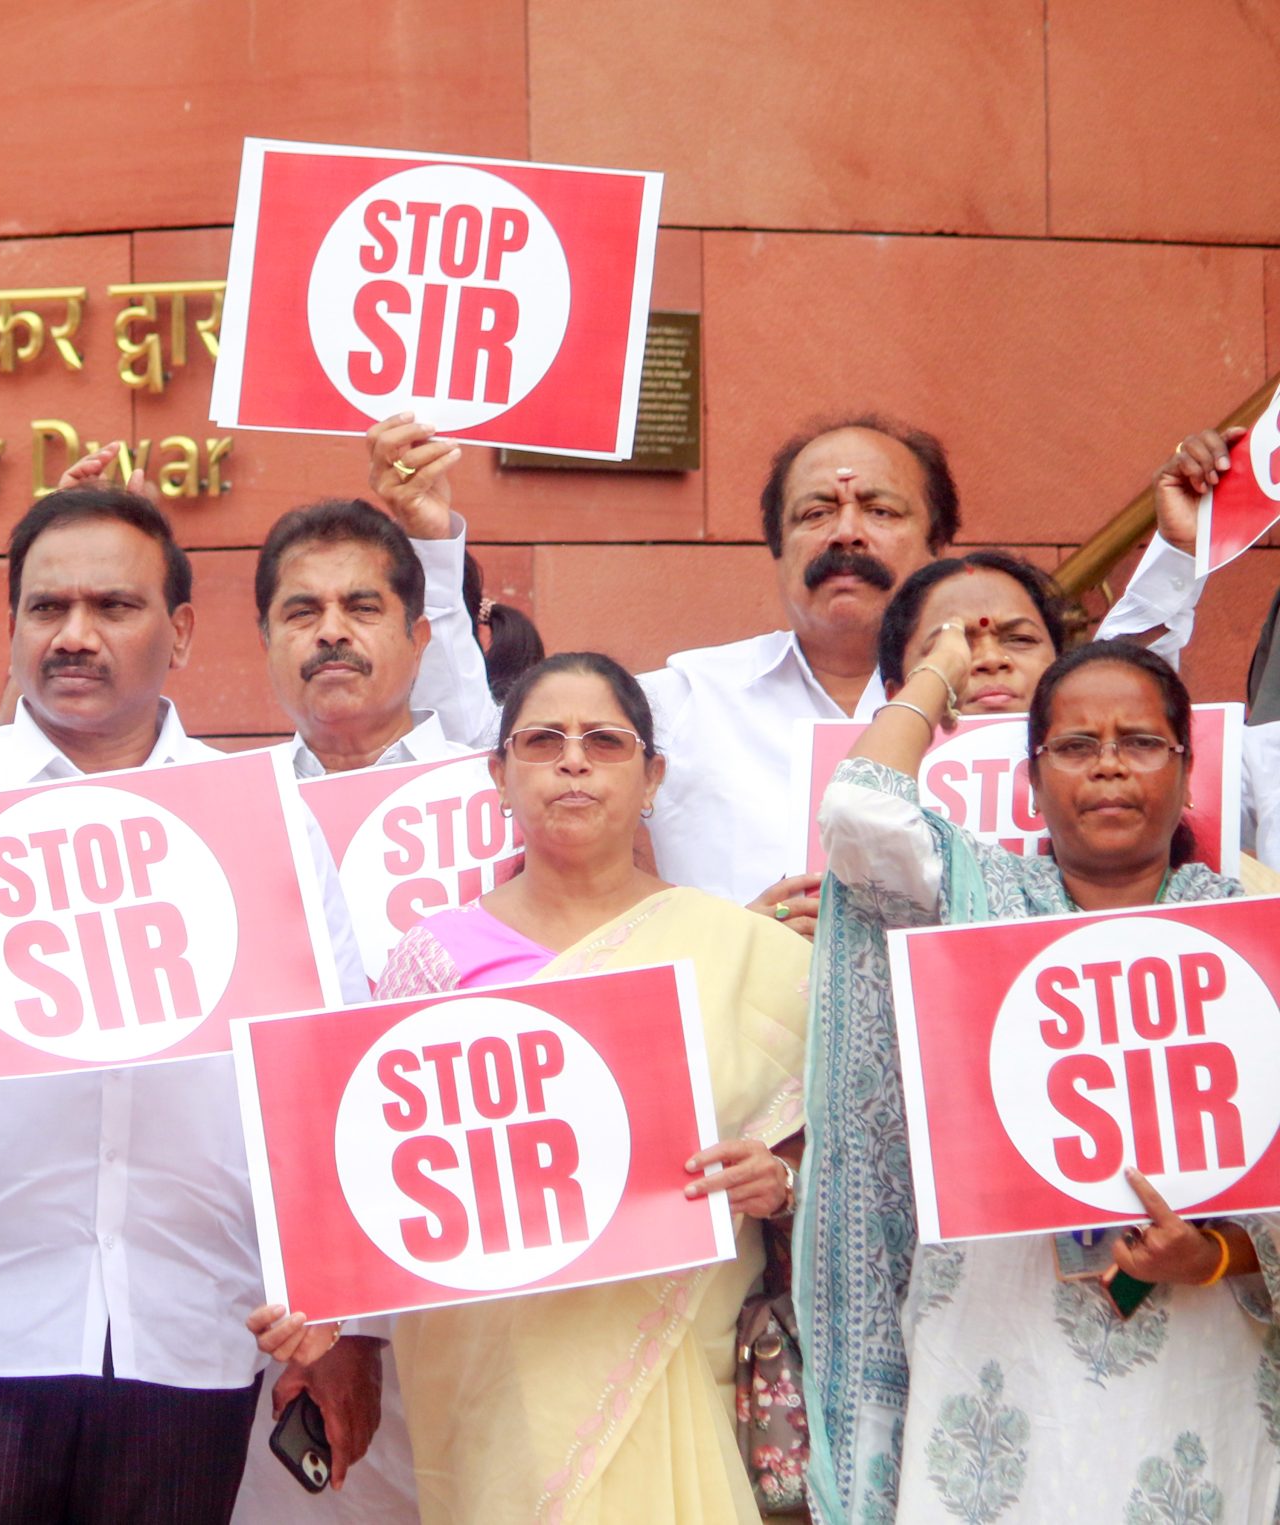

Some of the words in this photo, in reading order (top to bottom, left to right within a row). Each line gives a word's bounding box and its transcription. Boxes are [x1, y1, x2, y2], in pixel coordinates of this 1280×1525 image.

[359, 199, 530, 281] STOP
[347, 280, 520, 405] SIR
[382, 788, 525, 876] STO
[923, 758, 1048, 832] STO
[2, 901, 203, 1038] SIR
[1035, 952, 1228, 1050] STOP
[376, 1029, 565, 1132] STOP
[1046, 1041, 1247, 1184] SIR
[390, 1118, 590, 1263] SIR
